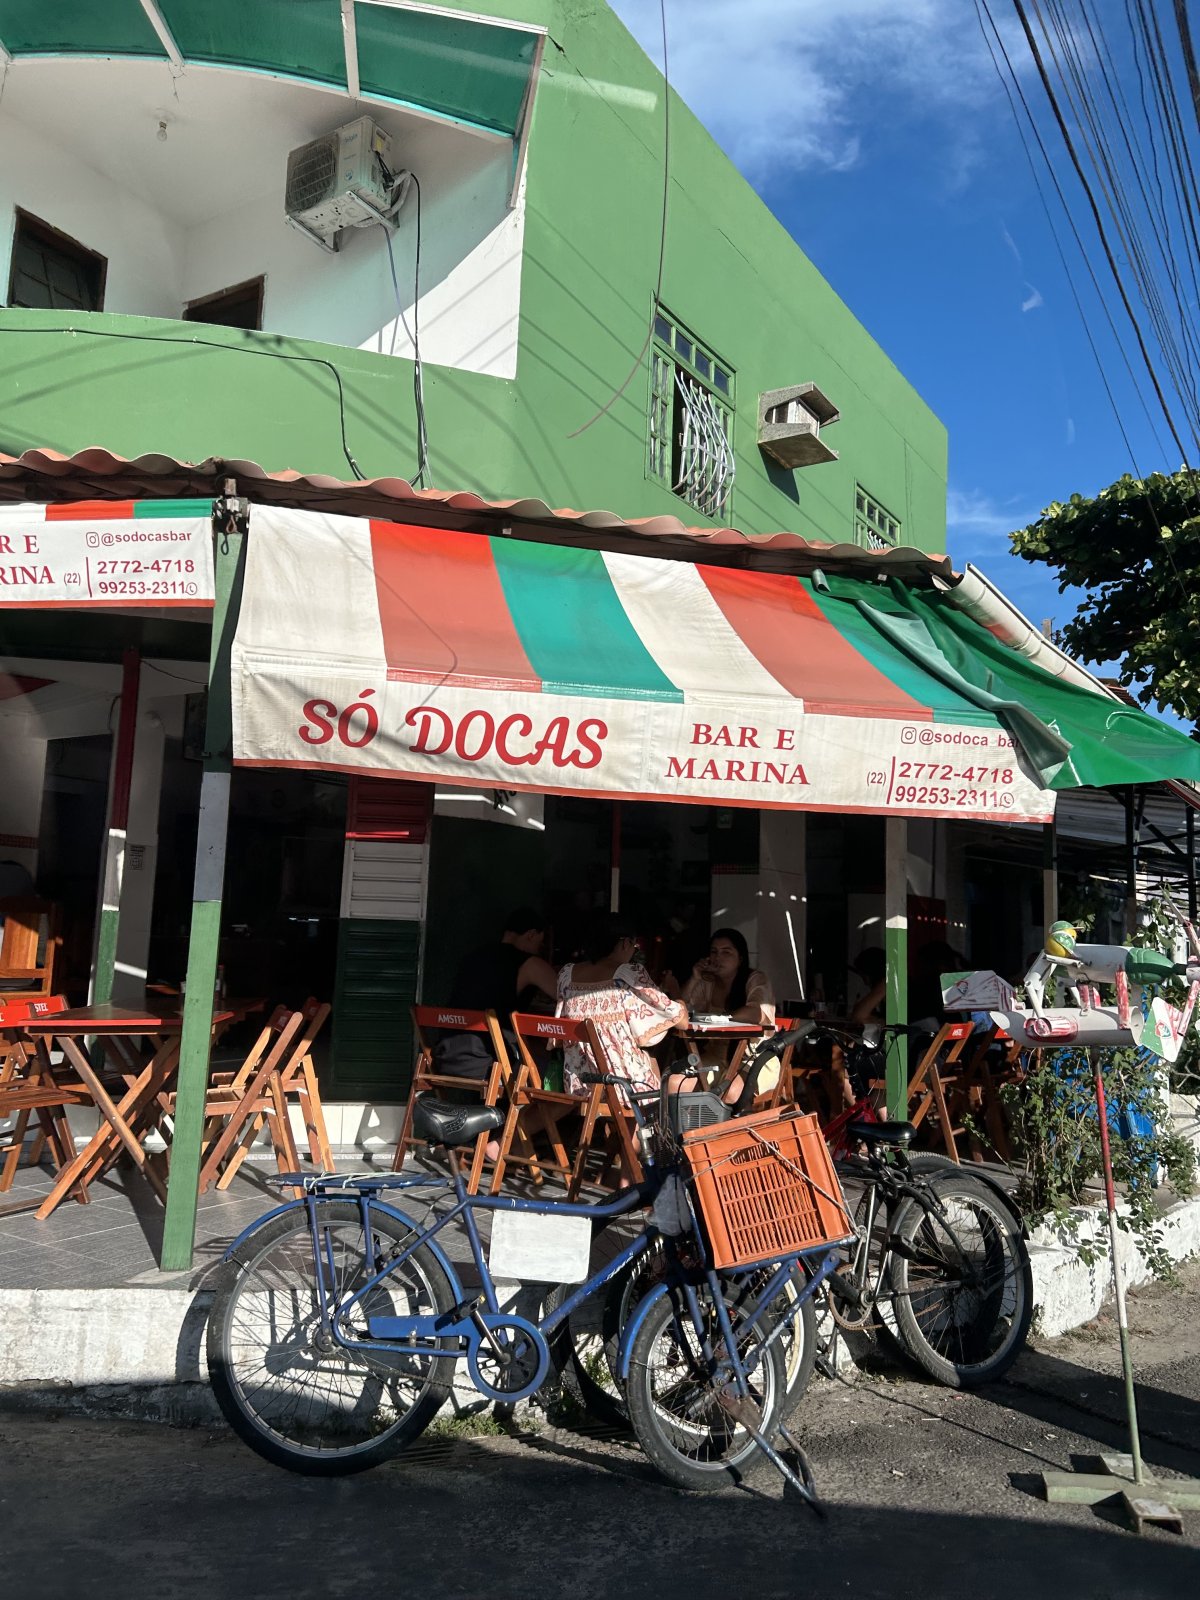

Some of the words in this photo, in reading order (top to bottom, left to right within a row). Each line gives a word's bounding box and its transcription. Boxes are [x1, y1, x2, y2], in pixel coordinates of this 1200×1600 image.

[0, 535, 16, 554] R
[22, 534, 40, 554] E
[101, 530, 192, 547] @sodocasbar
[0, 565, 56, 585] RINA
[97, 559, 195, 575] 2772-4718
[63, 572, 81, 586] (22)
[98, 580, 186, 594] 99253-2311
[298, 688, 379, 748] SÓ
[405, 706, 609, 770] DOCAS
[689, 723, 761, 749] BAR
[773, 728, 796, 751] E
[664, 756, 811, 785] MARINA
[866, 771, 887, 787] (22)
[898, 761, 1014, 784] 2772-4718
[894, 785, 998, 807] 99253-2311
[33, 1002, 49, 1013] STEL
[437, 1014, 468, 1025] AMSTEL
[537, 1022, 566, 1036] AMSTEL
